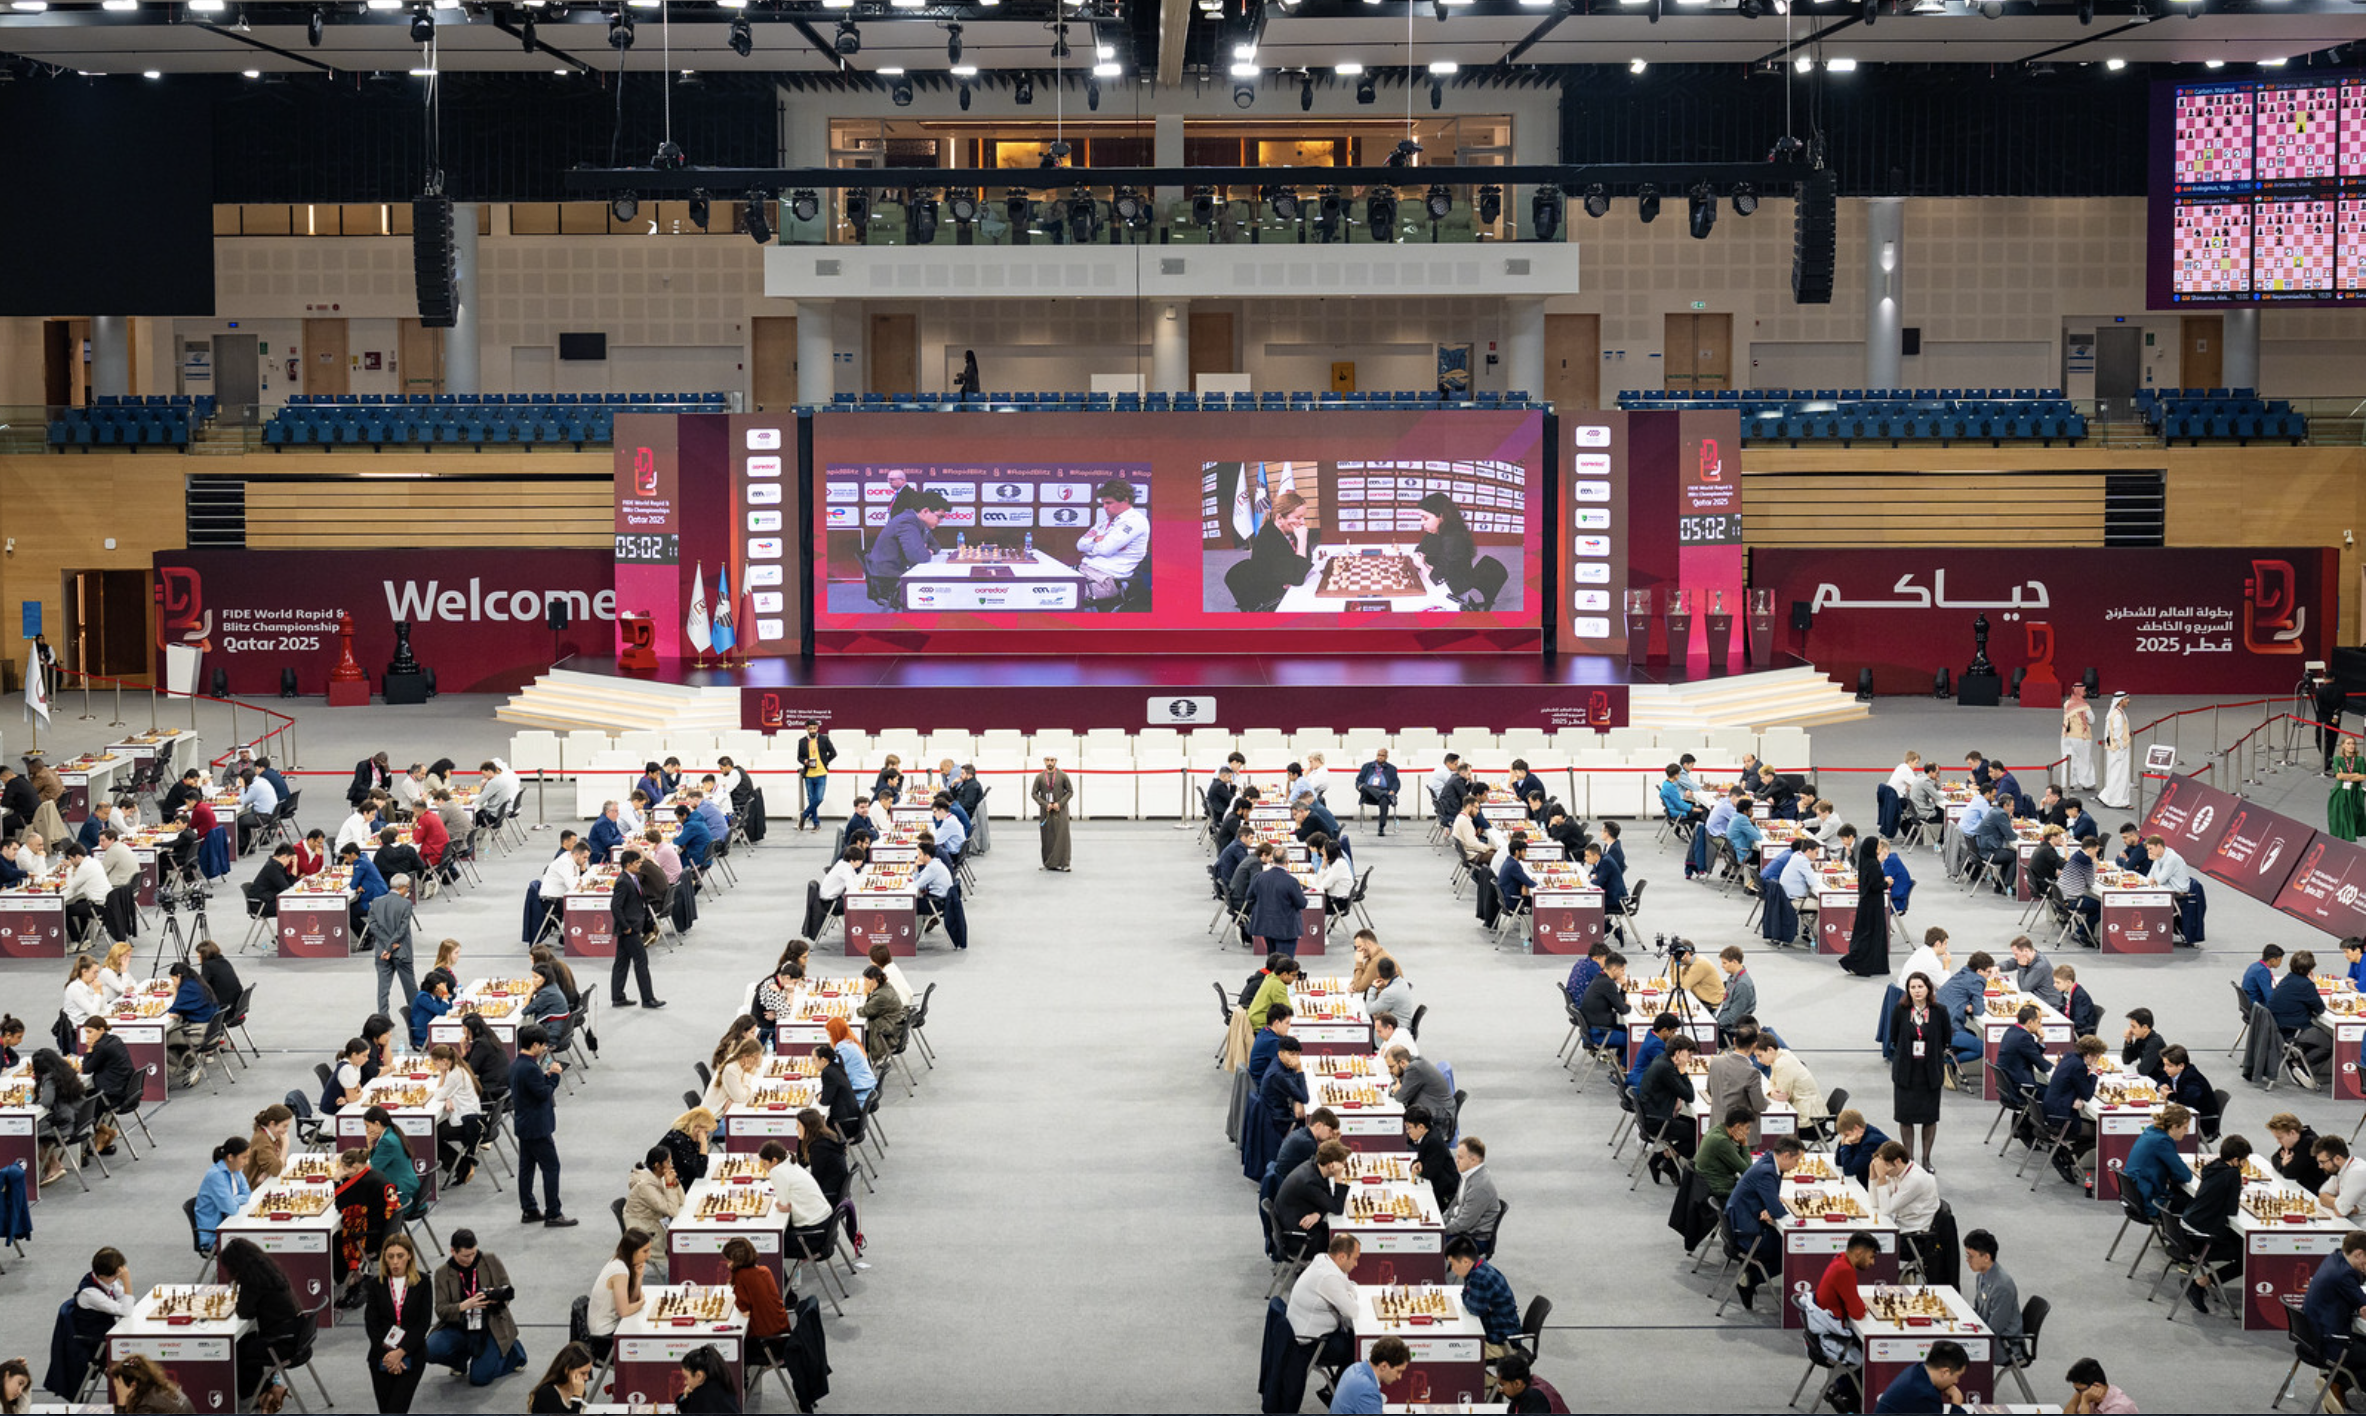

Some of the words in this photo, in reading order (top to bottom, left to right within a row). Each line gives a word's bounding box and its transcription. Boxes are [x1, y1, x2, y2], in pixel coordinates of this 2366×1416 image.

[826, 469, 859, 477] apidBlitz
[942, 468, 987, 477] #RapidBlitz
[1692, 499, 1712, 508] Qatar
[1713, 498, 1729, 506] 2025
[628, 515, 648, 525] Qatar
[649, 515, 666, 524] 2025
[1680, 517, 1726, 541] 05:02
[615, 536, 662, 558] 05:02
[975, 586, 1007, 594] ooredoo
[1811, 568, 2050, 622] حياكم
[383, 577, 615, 621] Welcome
[223, 609, 252, 619] FIDE
[254, 609, 293, 619] World
[296, 609, 333, 621] Rapid
[336, 609, 344, 619] &
[2105, 606, 2156, 621] للشطرنج
[2158, 606, 2193, 618] العالم
[2196, 606, 2233, 620] بطولة
[223, 622, 250, 631] Blitz
[252, 622, 340, 634] Championship
[2136, 621, 2182, 632] الخاطف
[2184, 623, 2192, 634] و
[2194, 621, 2233, 634] السريع
[223, 637, 276, 653] Qatar
[278, 637, 320, 651] 2025
[2136, 637, 2180, 652] 2025
[2183, 637, 2233, 655] قطر
